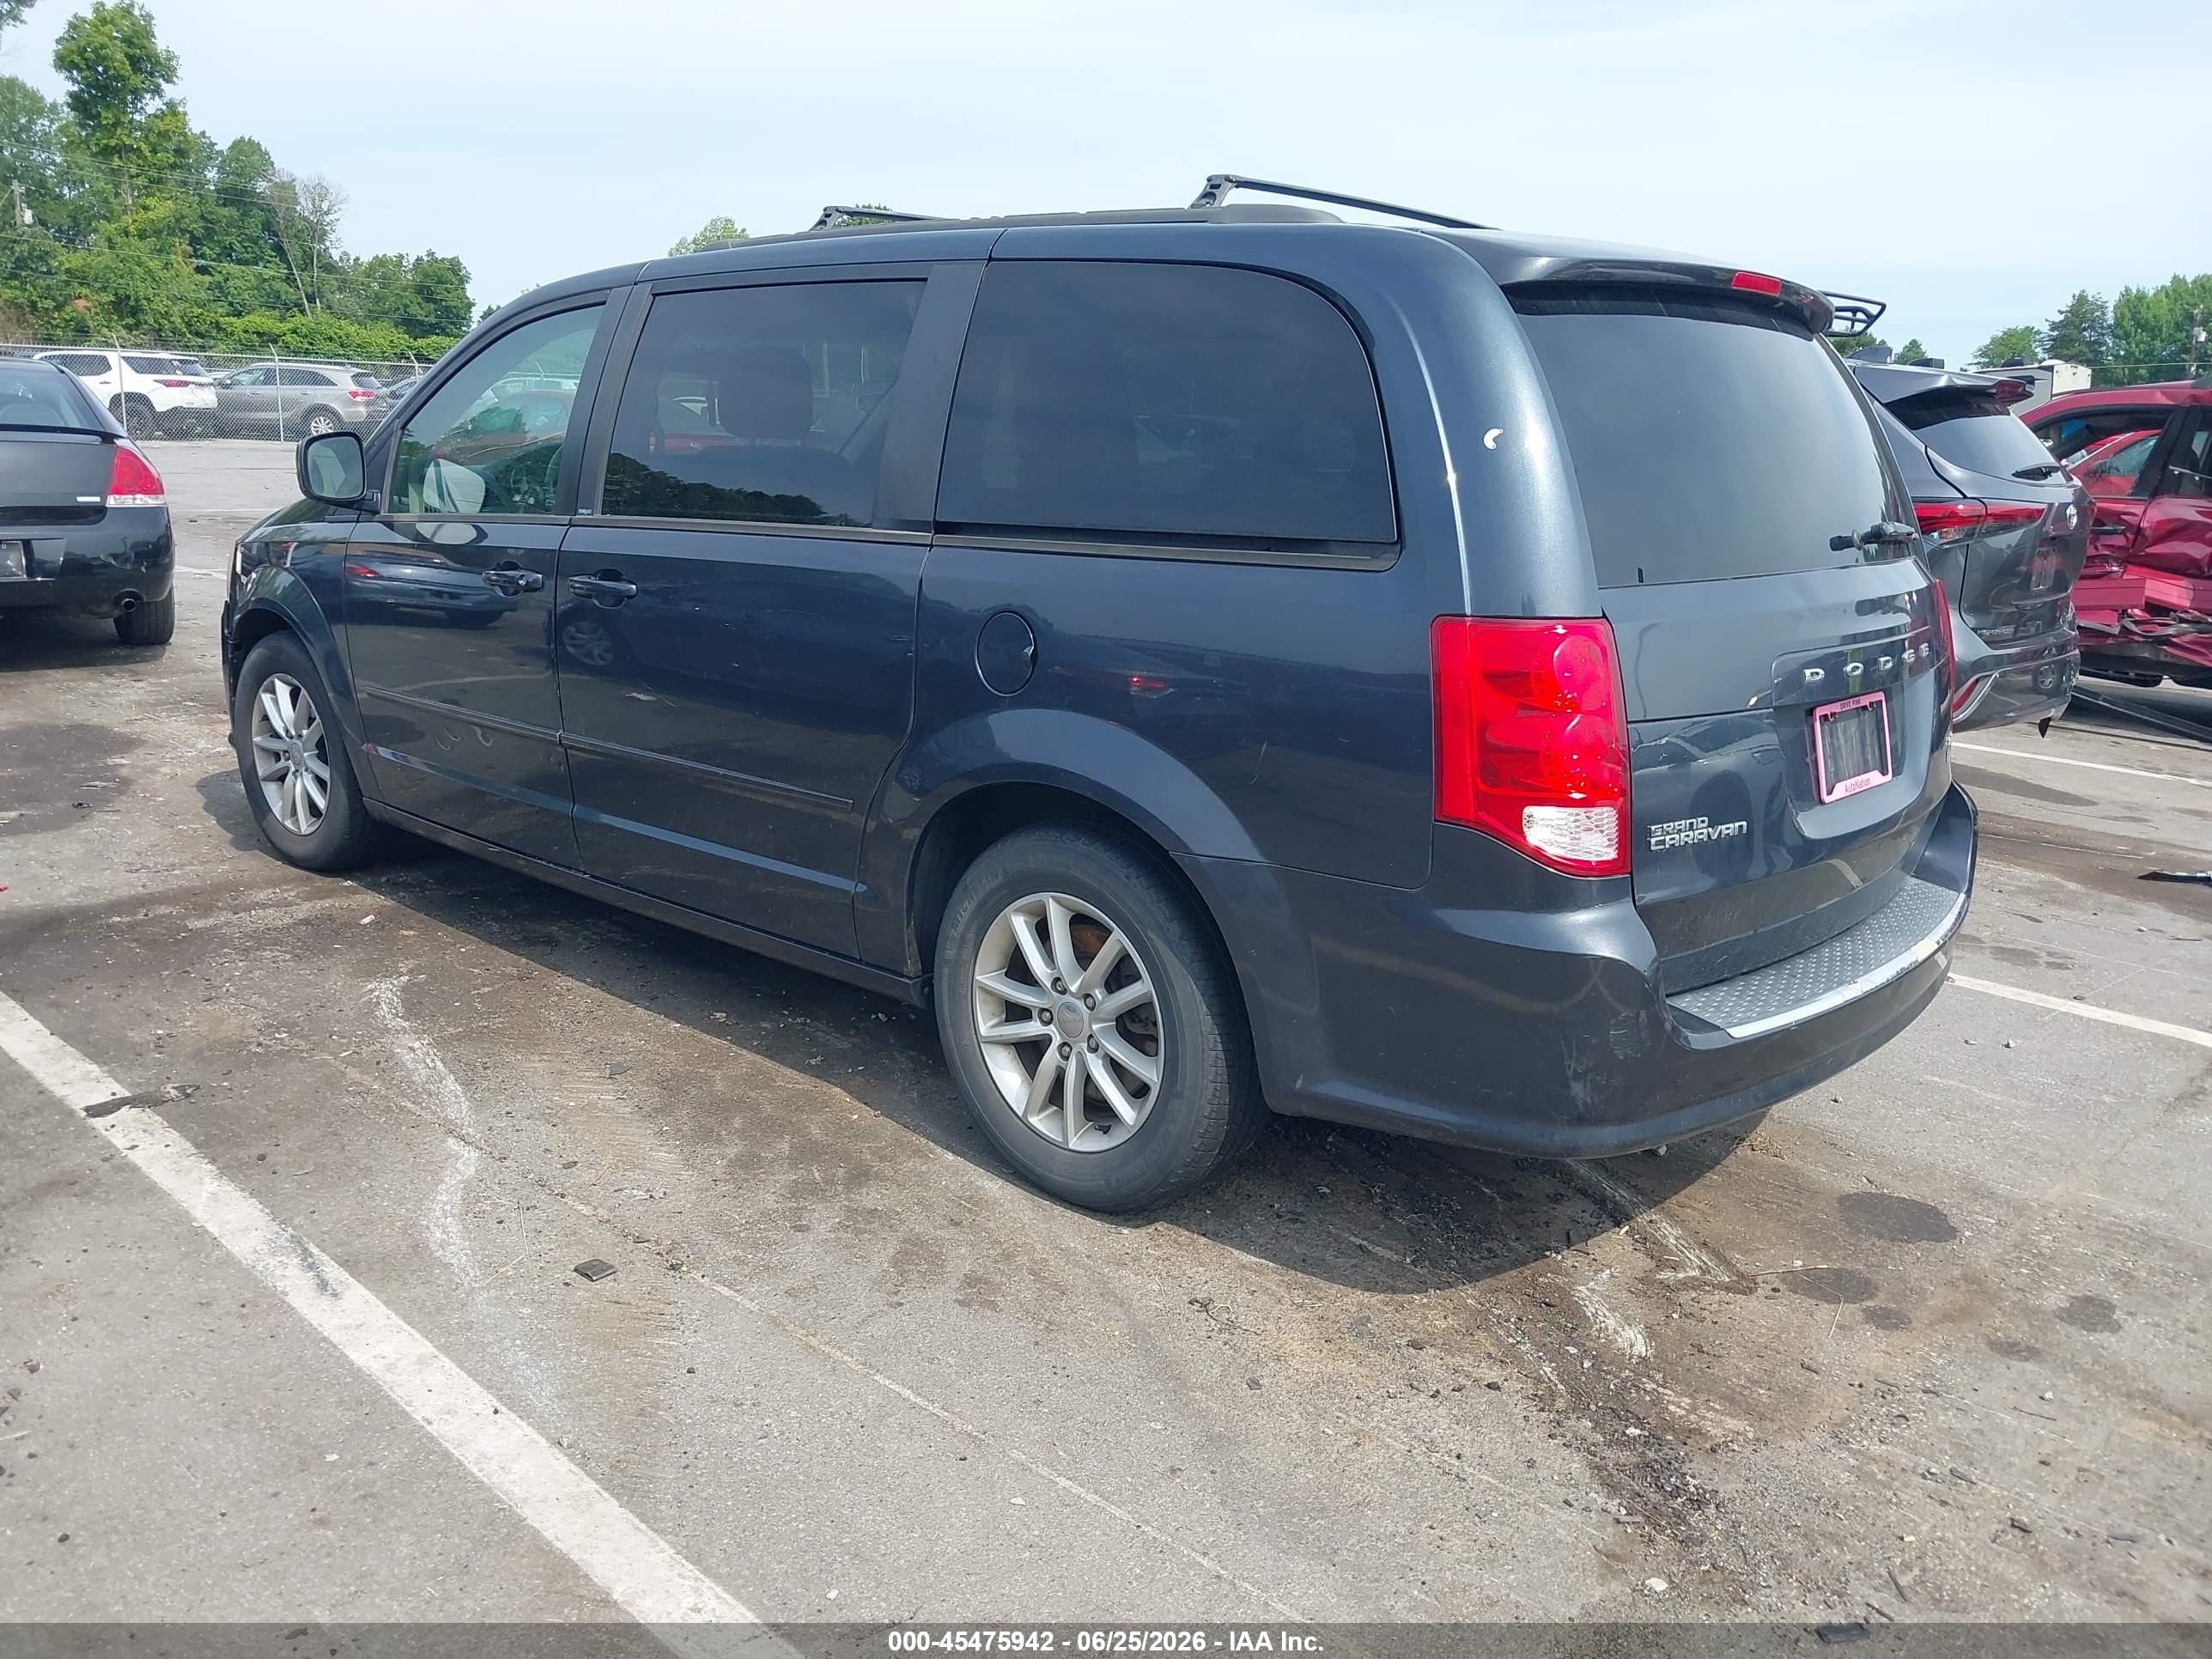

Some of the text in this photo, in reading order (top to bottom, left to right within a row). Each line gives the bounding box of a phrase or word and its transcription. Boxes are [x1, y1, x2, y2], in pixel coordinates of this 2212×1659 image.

[1803, 642, 1930, 683] DODGE
[1839, 700, 1851, 710] DRIVE
[1844, 776, 1871, 794] AutoNation
[1647, 817, 1709, 836] GRAND
[1647, 820, 1747, 851] CARAVAN
